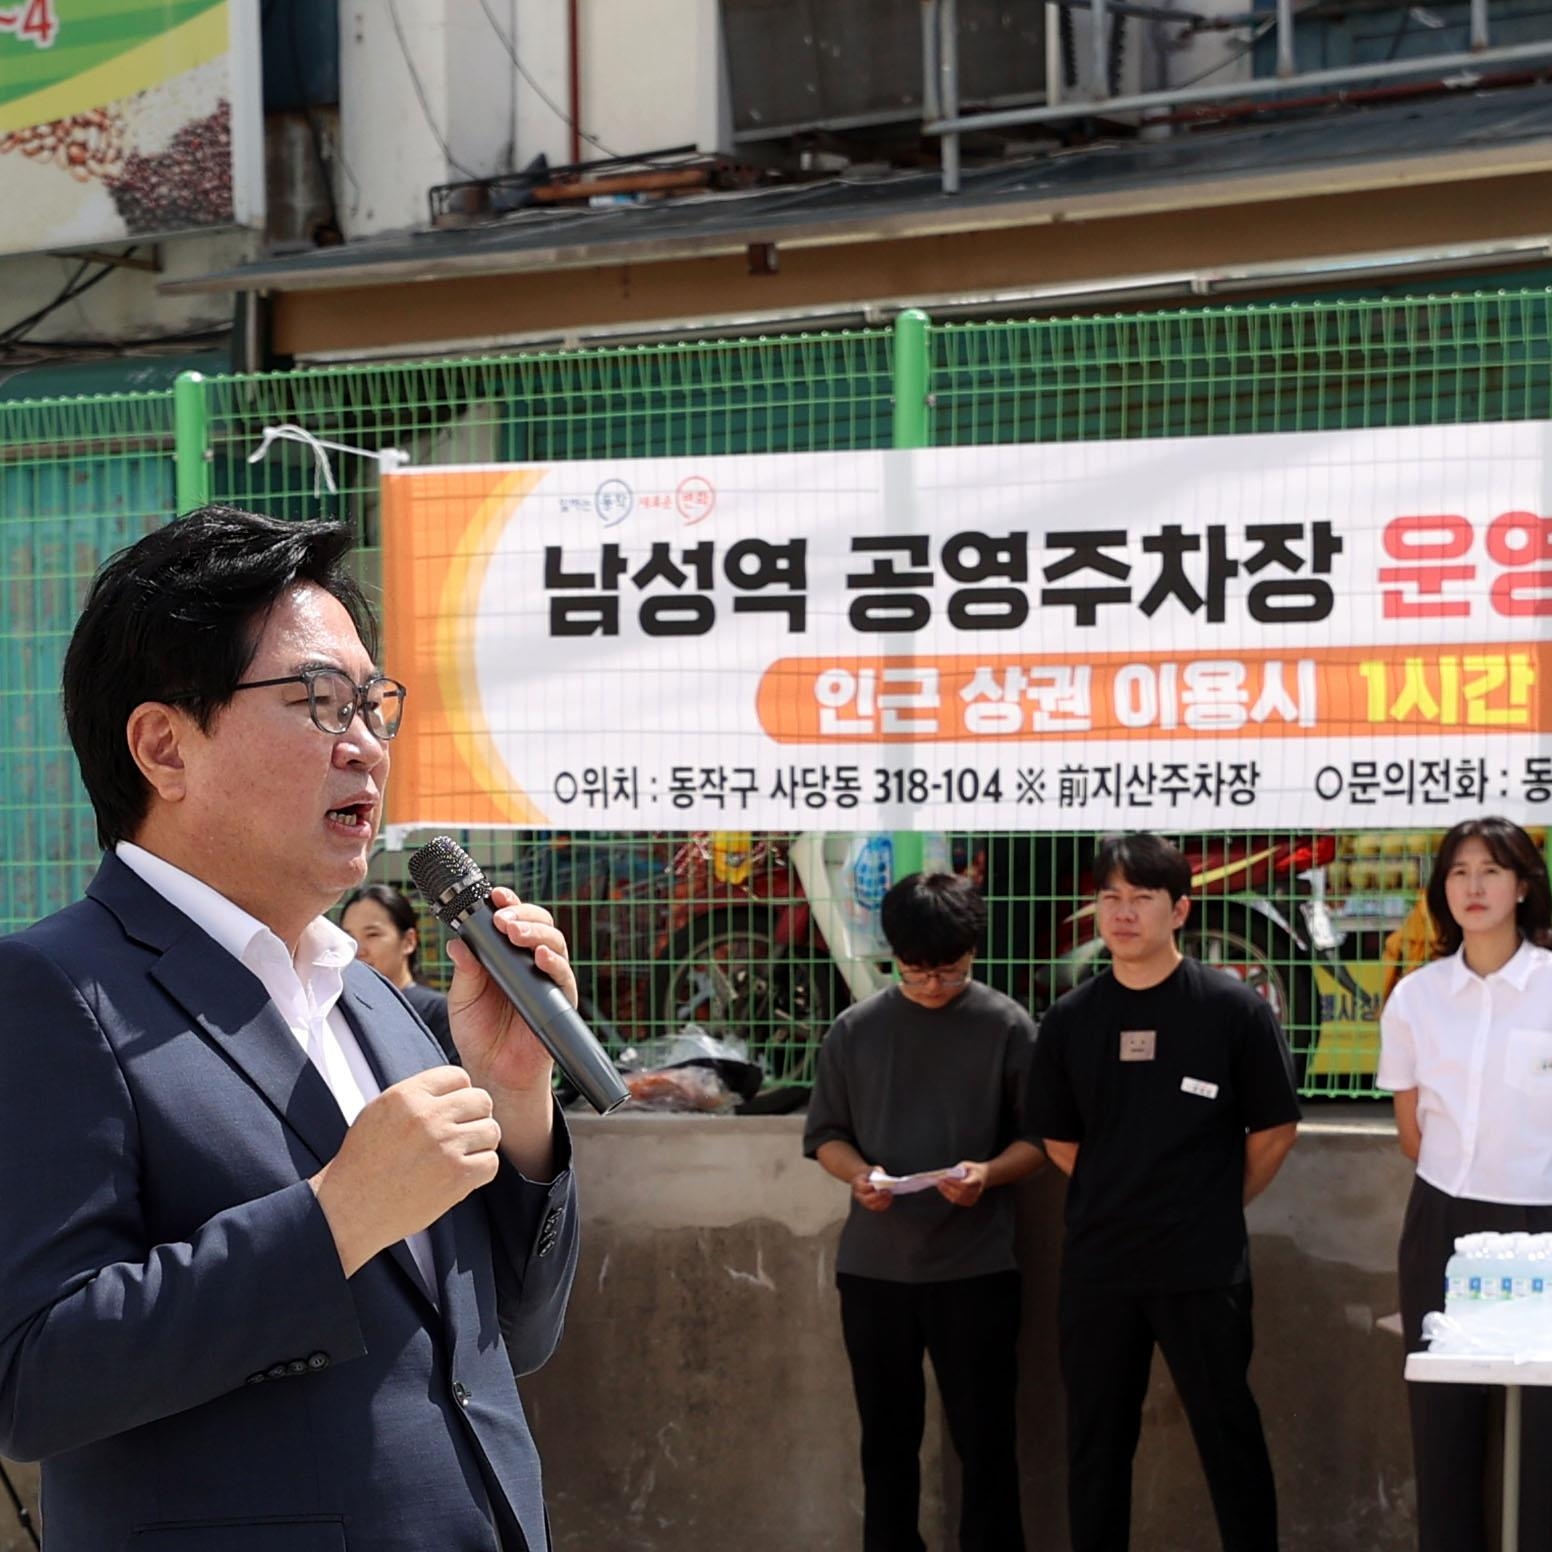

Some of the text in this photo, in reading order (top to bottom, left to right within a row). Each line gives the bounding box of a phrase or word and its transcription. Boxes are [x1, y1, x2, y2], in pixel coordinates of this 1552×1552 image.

[682, 489, 710, 511] 변화
[544, 538, 807, 637] 남성역
[847, 521, 1343, 633] 공영주차장
[814, 664, 941, 733] 인근
[959, 662, 1091, 733] 상권
[1113, 657, 1318, 730] 이용시
[1358, 653, 1537, 726] 1시간
[668, 766, 760, 809] 동작구
[769, 765, 862, 809] 사당동
[873, 767, 1004, 805] 318-104
[1057, 760, 1261, 808] 前지산주차장
